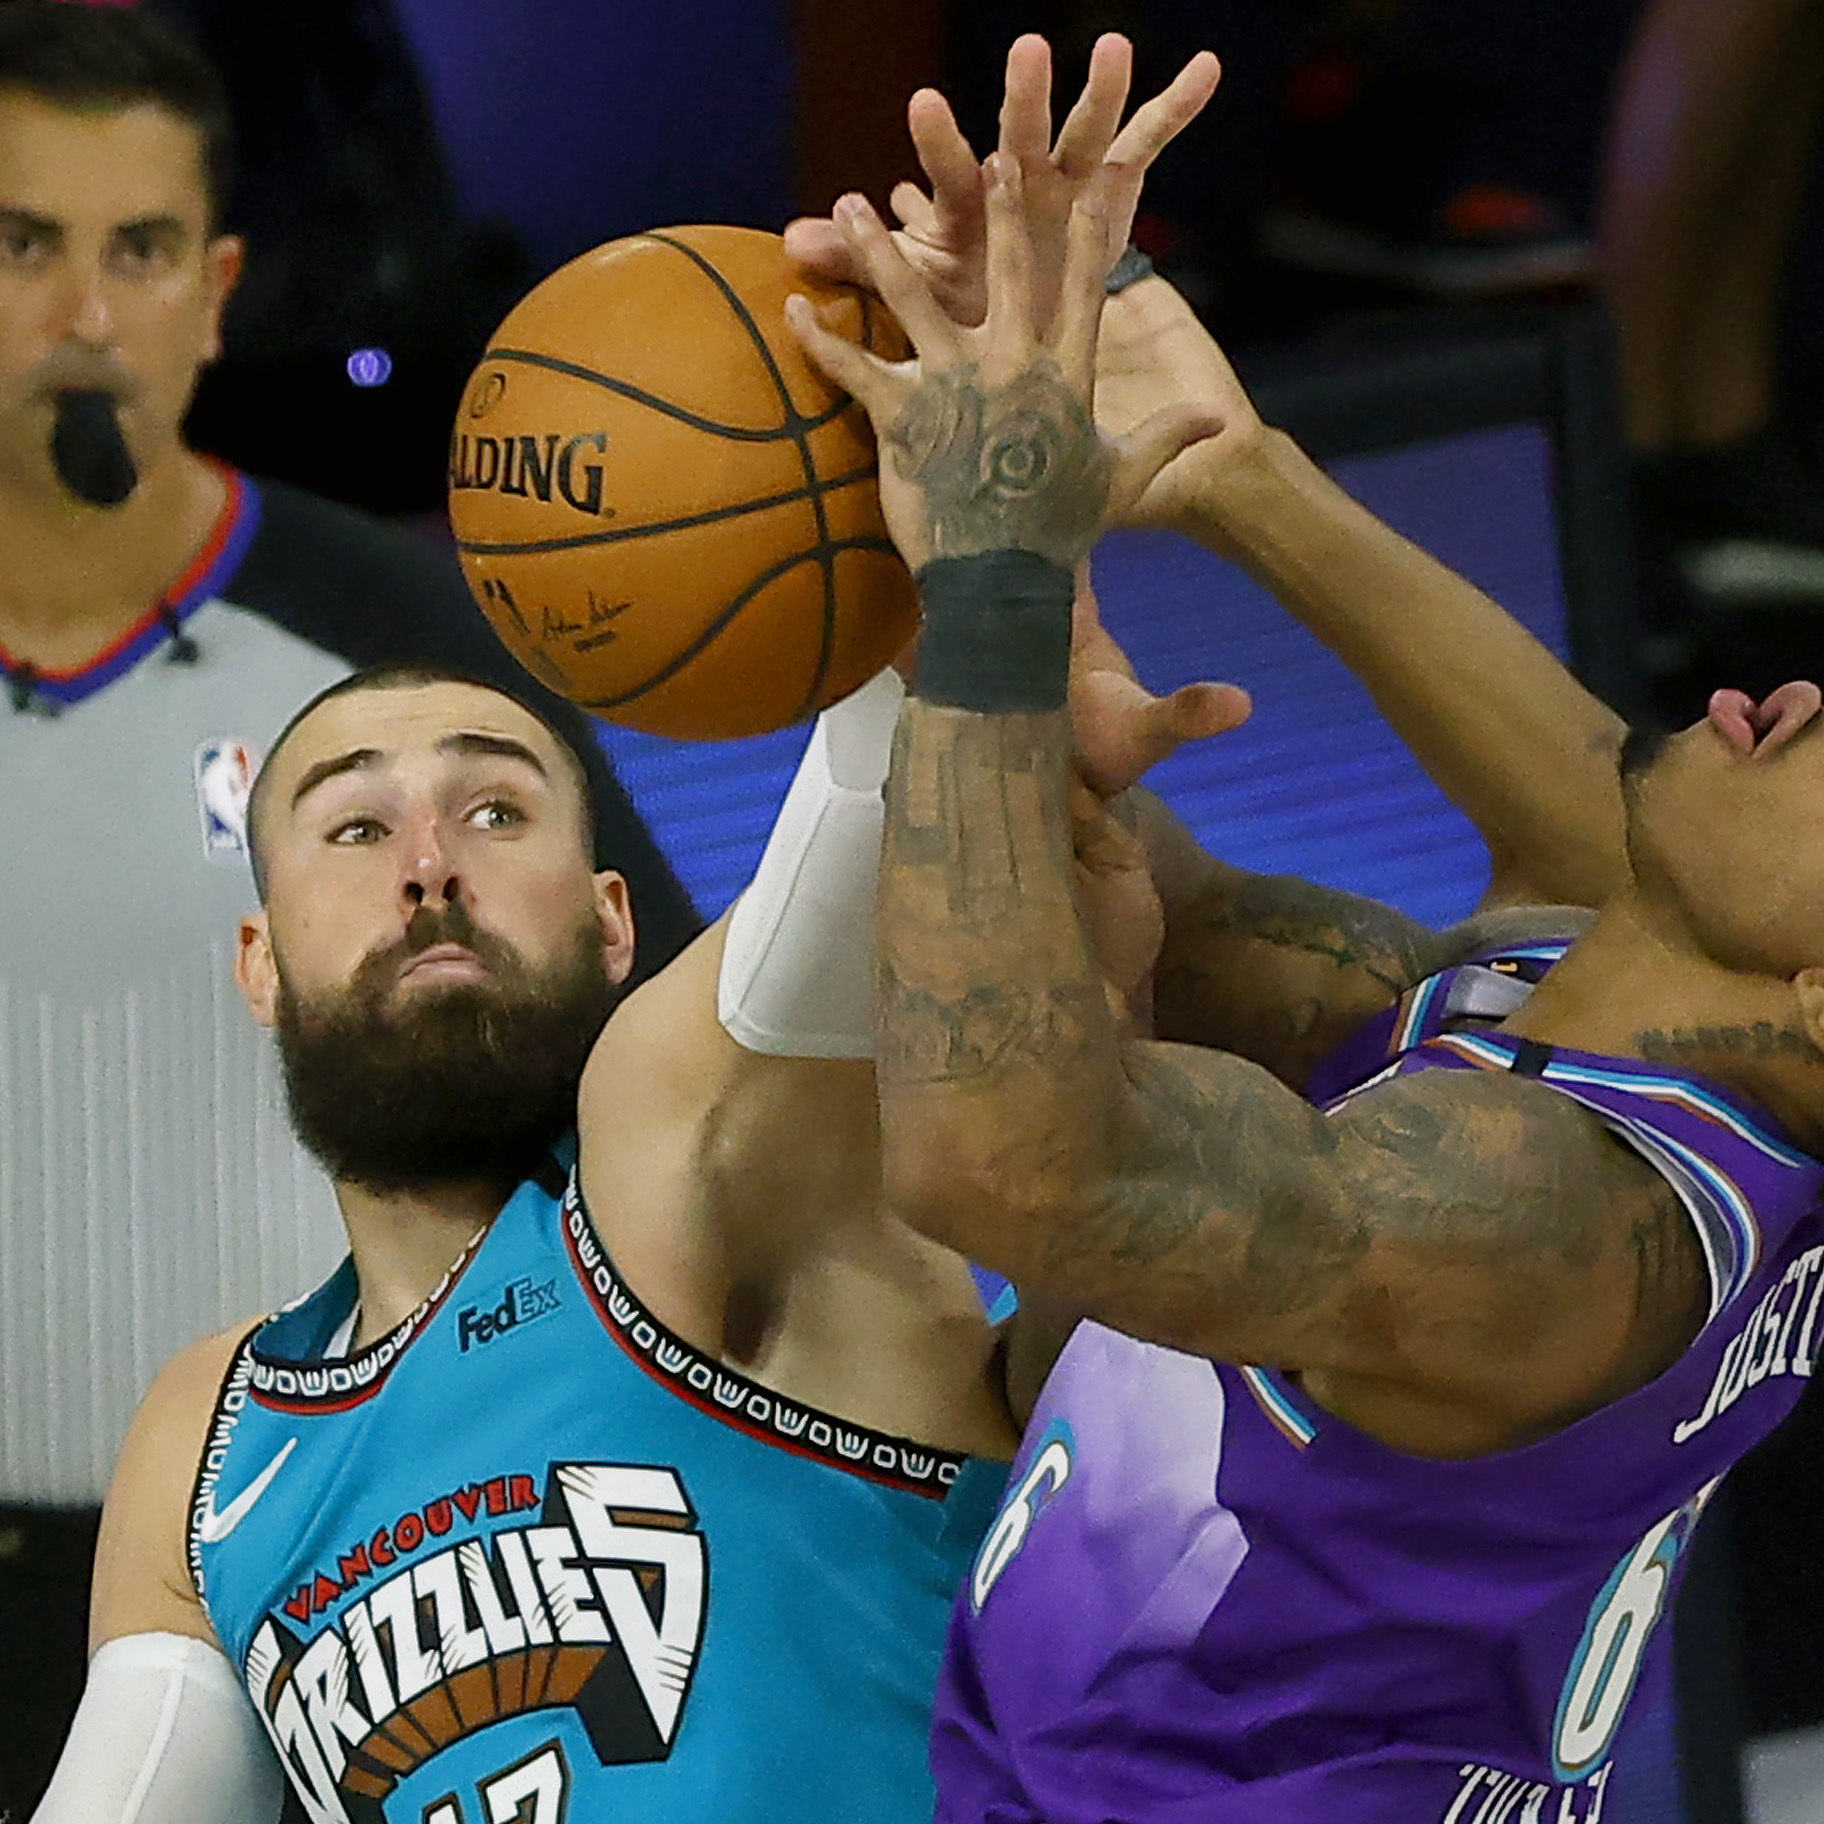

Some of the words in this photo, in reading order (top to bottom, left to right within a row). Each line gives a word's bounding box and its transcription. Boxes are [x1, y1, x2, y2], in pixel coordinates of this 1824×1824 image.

[457, 1275, 563, 1354] FedEx
[282, 1473, 541, 1627] VANCOUVER
[971, 1422, 1075, 1614] 6
[1553, 1474, 1721, 1782] 6
